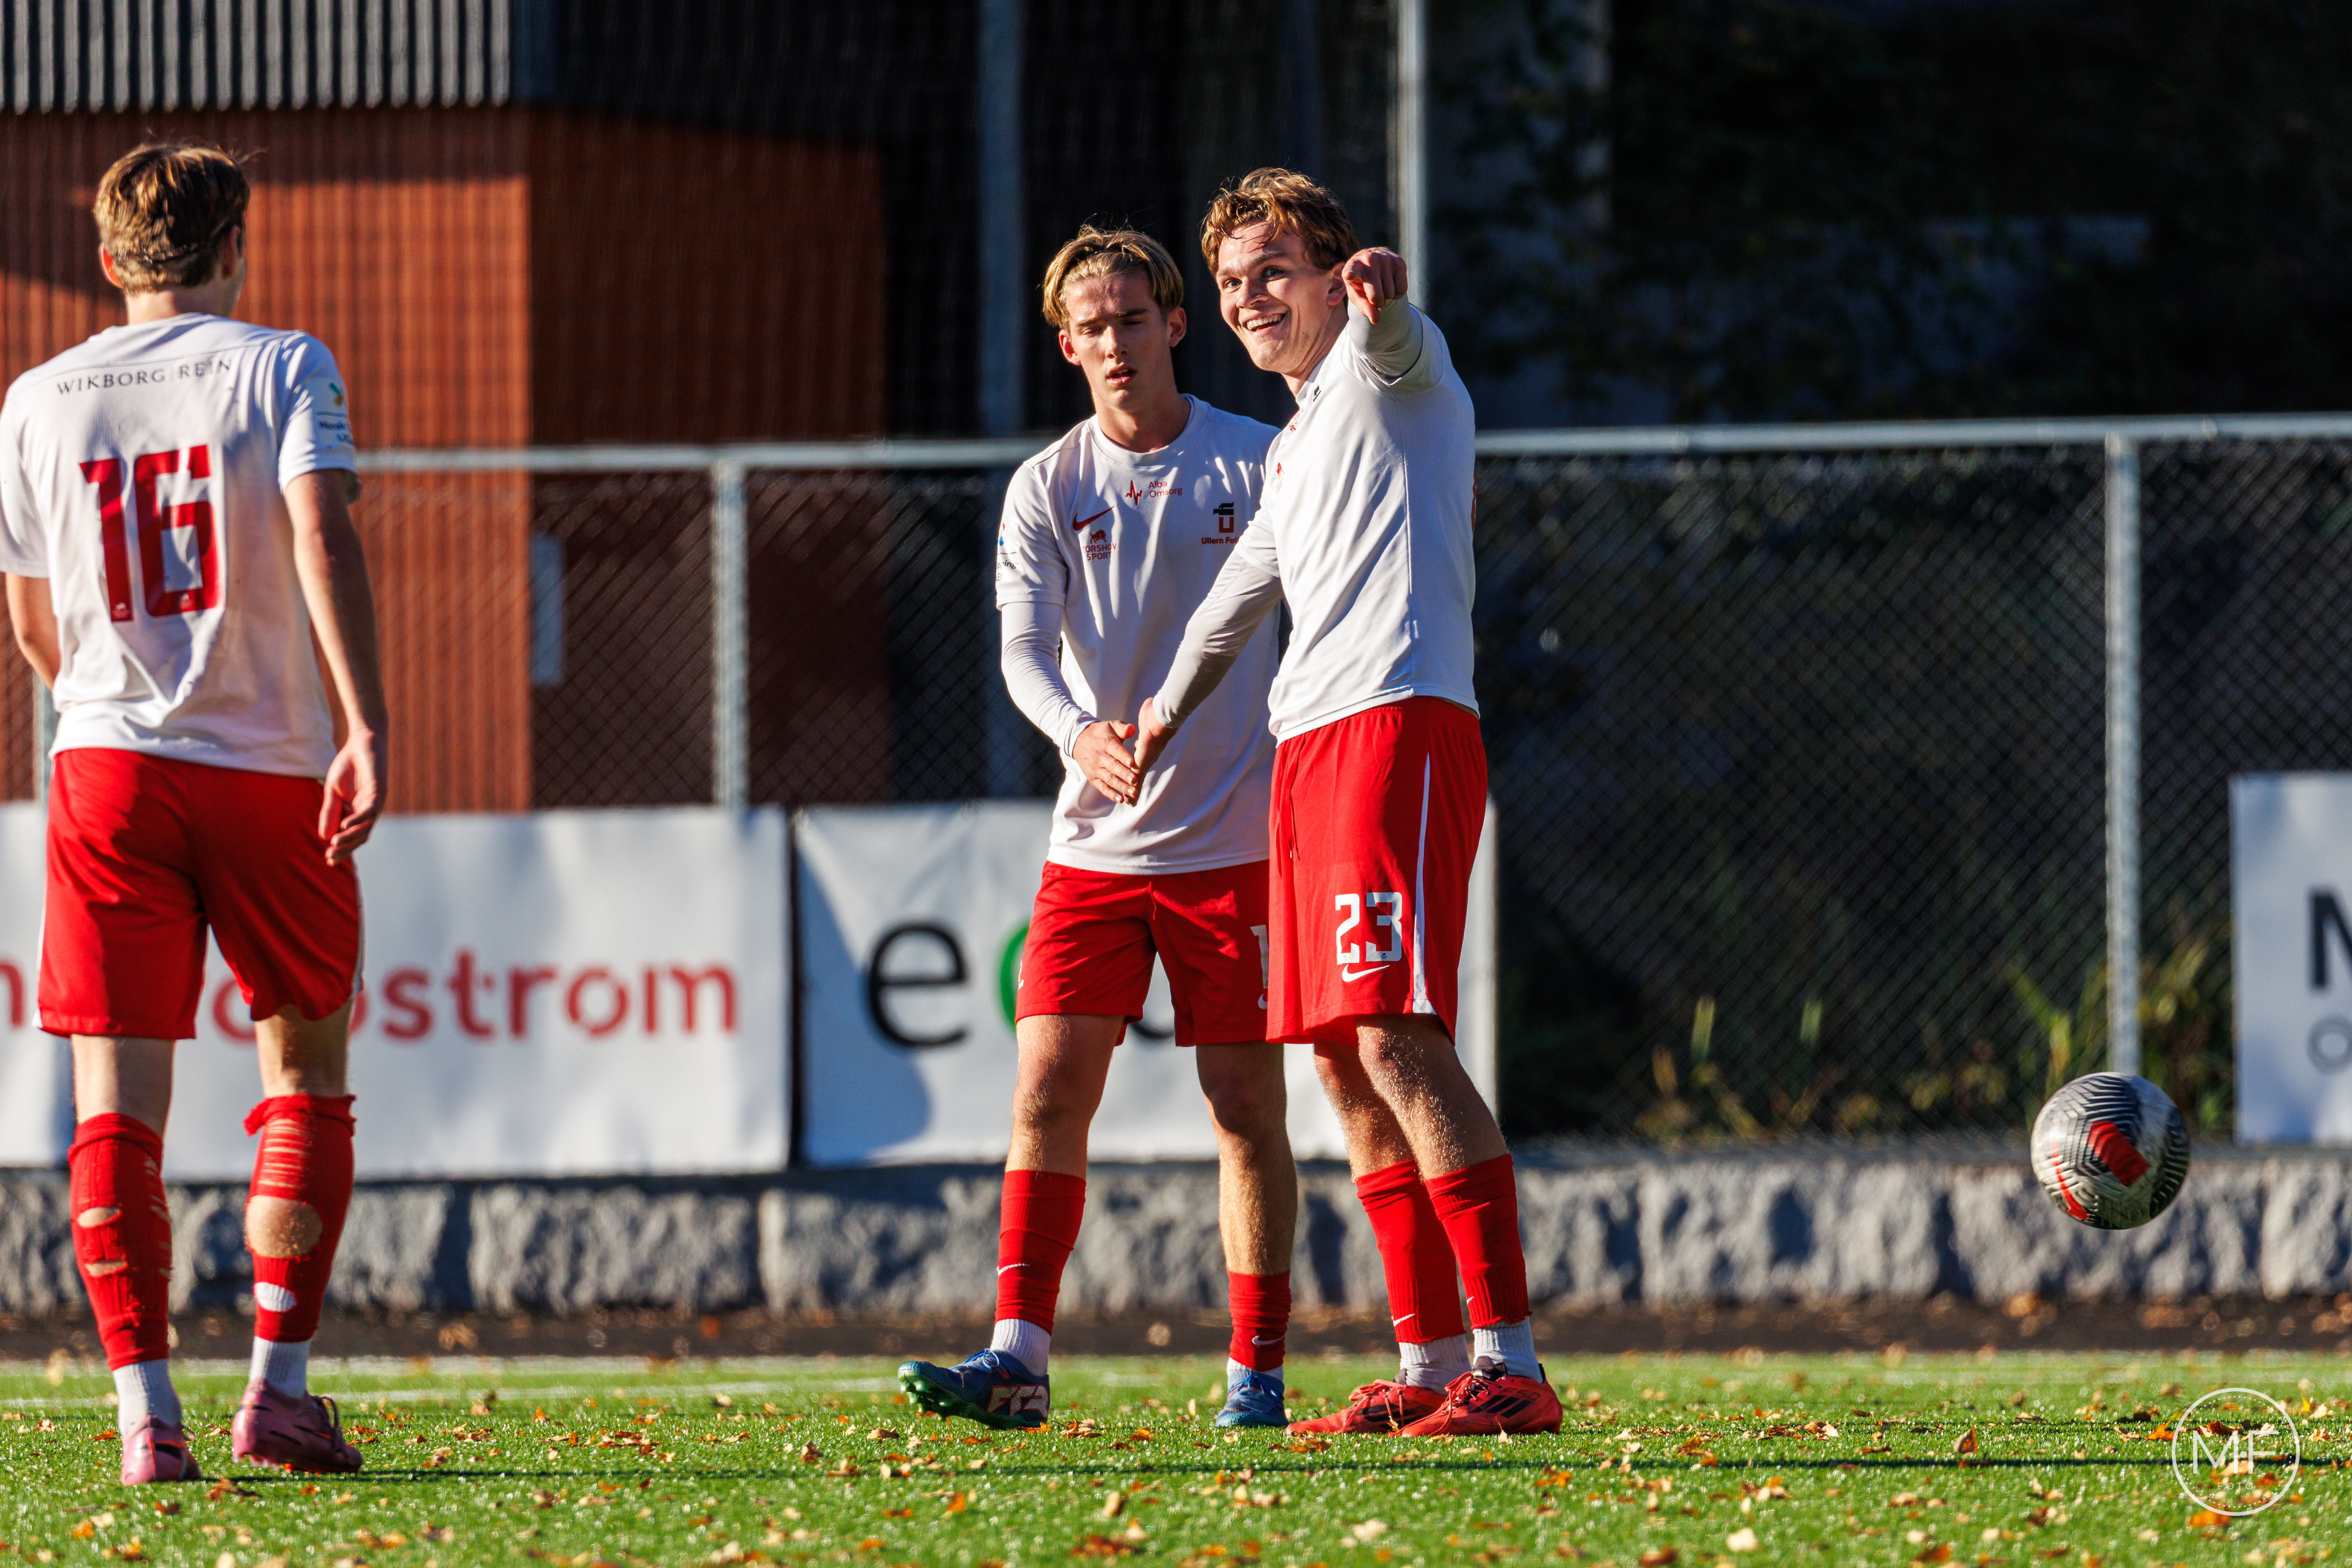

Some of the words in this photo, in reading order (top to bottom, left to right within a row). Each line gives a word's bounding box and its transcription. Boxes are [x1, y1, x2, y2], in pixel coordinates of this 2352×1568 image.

[57, 368, 166, 395] WIKBORG
[179, 359, 232, 380] REIN
[1149, 480, 1167, 489] Alba
[1149, 488, 1183, 498] Omsorg
[79, 444, 224, 624] 16
[1082, 543, 1117, 553] TORSHOV
[1086, 552, 1112, 560] SPORT
[1335, 892, 1402, 965] 23
